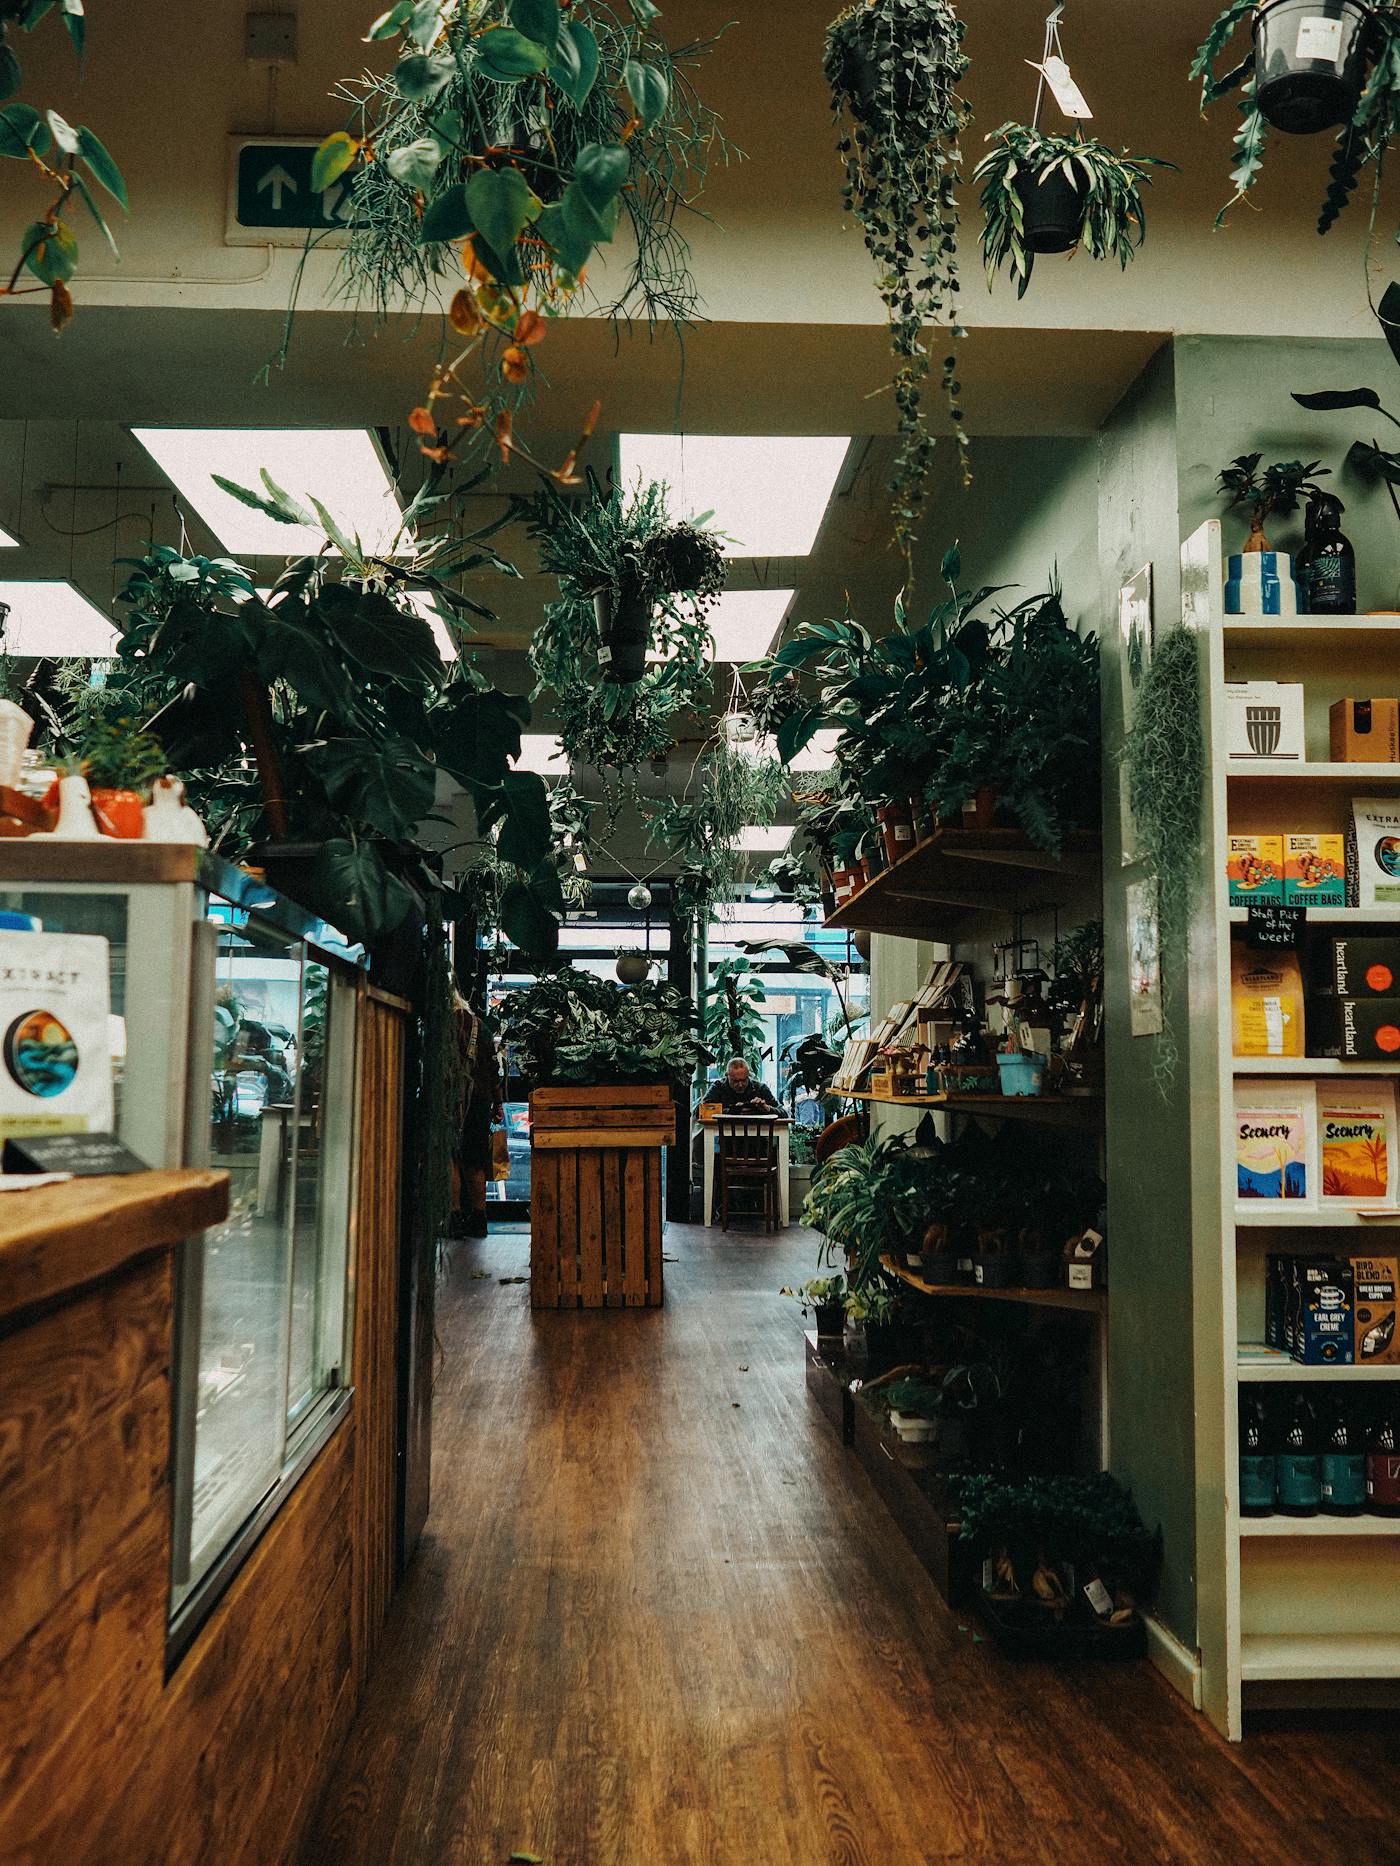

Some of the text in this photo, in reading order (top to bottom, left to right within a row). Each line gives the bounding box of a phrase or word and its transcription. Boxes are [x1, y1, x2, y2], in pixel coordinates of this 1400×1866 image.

[1366, 814, 1400, 823] EXTRA
[1229, 895, 1282, 907] COFFEE BAGS
[1288, 894, 1343, 905] COFFEE BAGS
[1251, 908, 1300, 920] Staff Pick
[1266, 920, 1292, 931] of the
[1335, 941, 1349, 995] heartland
[4, 967, 80, 984] XTRACT
[1343, 1001, 1358, 1056] heartland
[1239, 1124, 1291, 1140] Scenery
[1326, 1123, 1375, 1139] Scenery
[1356, 1261, 1373, 1270] BIRD
[1356, 1270, 1380, 1280] BLEND
[1359, 1285, 1374, 1293] GREAT
[1313, 1312, 1346, 1322] EARL GREY
[1319, 1322, 1340, 1332] CREME
